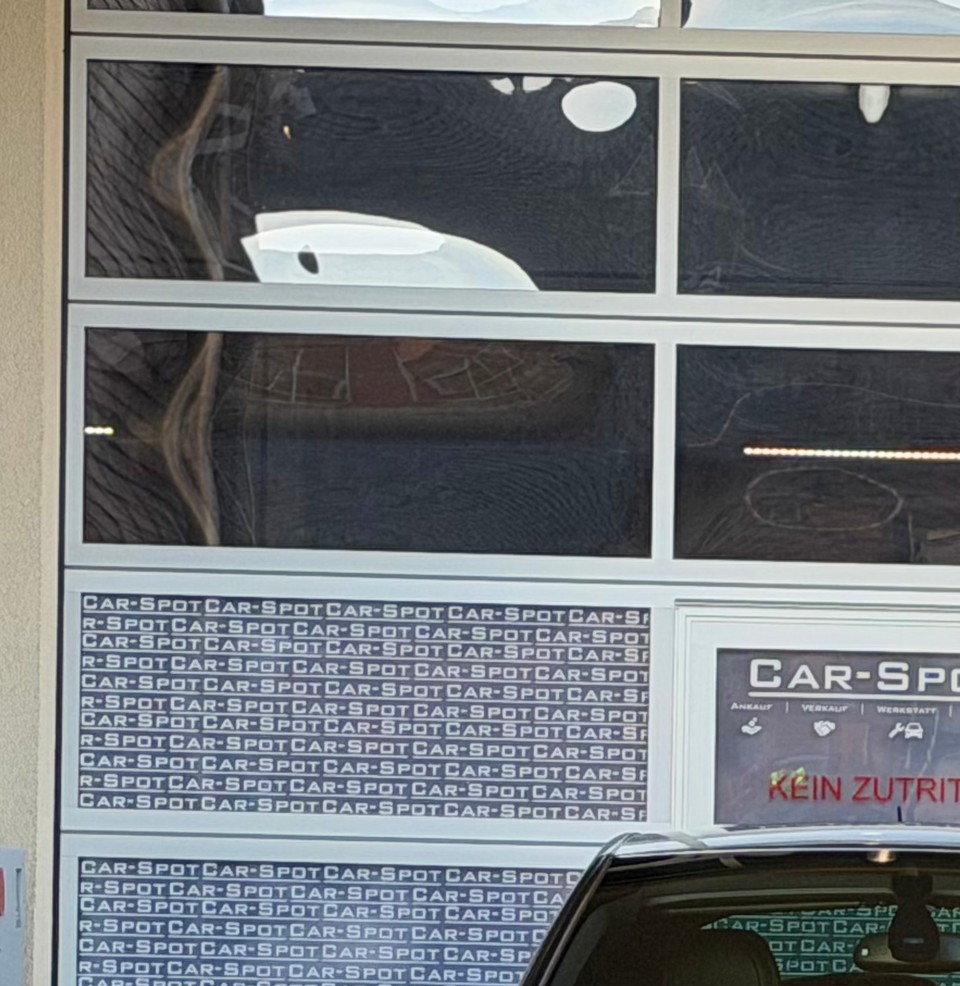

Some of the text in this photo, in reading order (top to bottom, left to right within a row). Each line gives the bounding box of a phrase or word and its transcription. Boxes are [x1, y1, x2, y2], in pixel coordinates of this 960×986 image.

[83, 595, 566, 623] CAR-SPOT CAR-SPOT CAR-SPOT CAR-SPOT
[172, 618, 290, 635] CAR-SPOT
[293, 622, 411, 639] CAR-SPOT
[415, 625, 533, 642] CAR-SPOT
[83, 634, 565, 661] CAR-SPOT CAR-SPOT CAR-SPOT CAR-SPOT
[171, 656, 289, 673] CAR-SPOT
[293, 660, 411, 677] CAR-SPOT
[414, 663, 532, 680] CAR-SPOT
[82, 674, 564, 701] CAR-SPOT CAR-SPOT CAR-SPOT CAR-SPOT
[170, 697, 288, 714] CAR-SPOT
[292, 700, 410, 717] CAR-SPOT
[413, 703, 531, 720] CAR-SPOT
[731, 702, 773, 711] ANKAUF
[801, 703, 848, 713] VERKAUF
[877, 705, 937, 714] WERKSTATT
[81, 712, 563, 739] CAR-SPOT CAR-SPOT CAR-SPOT CAR-SPOT
[170, 735, 288, 752] CAR-SPOT
[291, 738, 409, 755] CAR-SPOT
[412, 741, 530, 758] CAR-SPOT
[80, 753, 563, 779] CAR-SPOT CAR-SPOT CAR-SPOT CAR-SPOT
[169, 775, 287, 792] CAR-SPOT
[290, 779, 408, 796] CAR-SPOT
[411, 782, 529, 799] CAR-SPOT
[769, 774, 842, 802] KEIN
[80, 793, 562, 819] CAR-SPOT CAR-SPOT CAR-SPOT CAR-SPOT
[80, 859, 563, 885] CAR-SPOT CAR-SPOT CAR-SPOT CAR-SPOT
[169, 881, 530, 904] CAR-SPOT CAR-SPOT CAR-SPOT
[80, 897, 440, 920] CAR-SPOT CAR-SPOT CAR-SPOT
[168, 920, 529, 942] CAR-SPOT CAR-SPOT CAR-SPOT
[79, 938, 439, 960] CAR-SPOT CAR-SPOT CAR-SPOT
[167, 960, 285, 977] CAR-SPOT
[288, 963, 406, 980] CAR-SPOT
